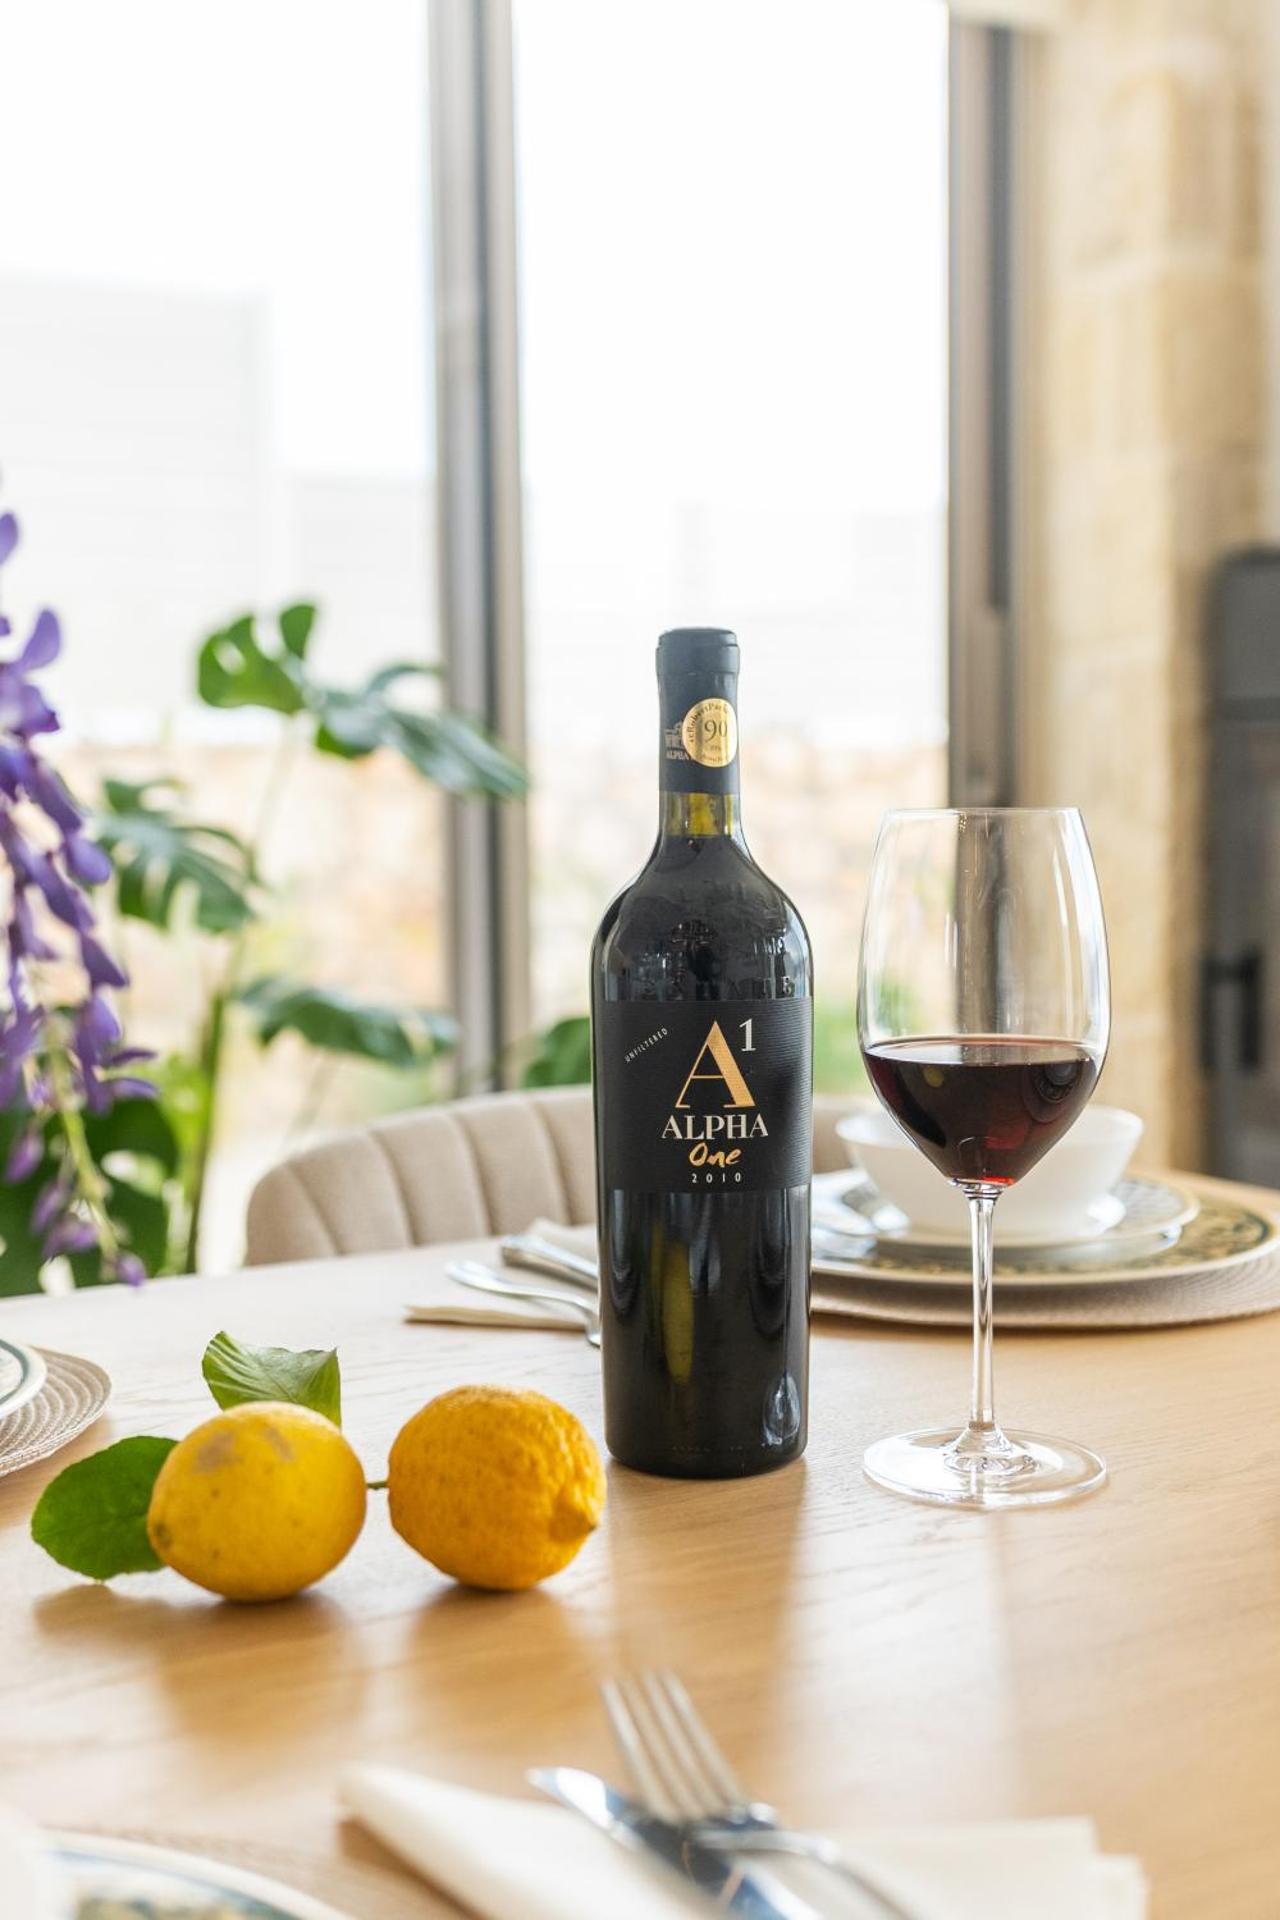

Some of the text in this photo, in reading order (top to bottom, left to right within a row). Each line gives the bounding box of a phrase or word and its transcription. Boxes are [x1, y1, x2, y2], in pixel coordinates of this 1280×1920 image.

[704, 719, 728, 742] 90
[624, 1027, 668, 1064] UNFILTERED
[675, 1018, 757, 1109] A 1
[661, 1113, 769, 1140] ALPHA
[688, 1142, 742, 1168] One
[692, 1172, 742, 1184] 2010
